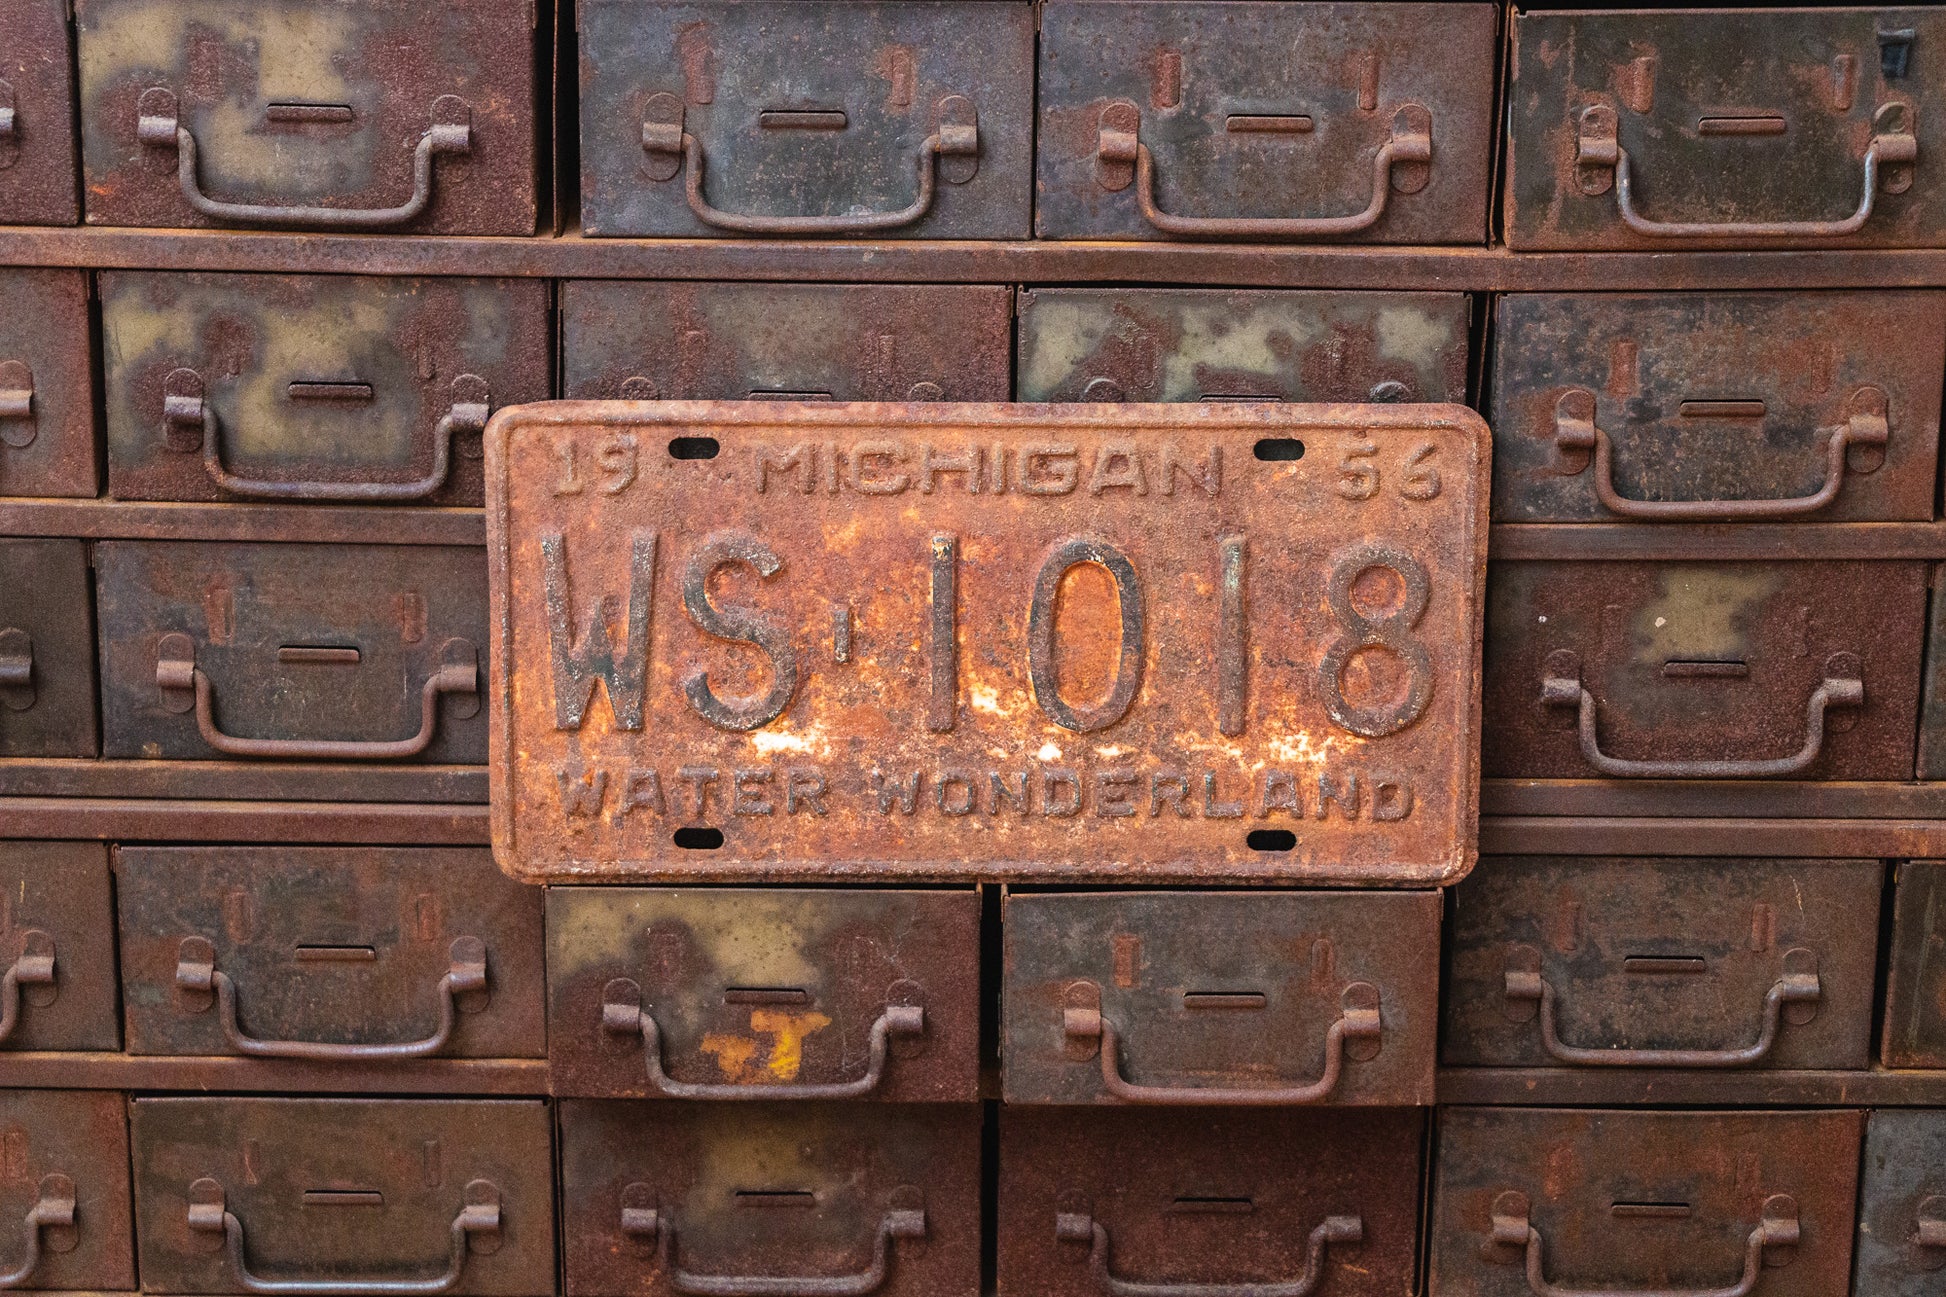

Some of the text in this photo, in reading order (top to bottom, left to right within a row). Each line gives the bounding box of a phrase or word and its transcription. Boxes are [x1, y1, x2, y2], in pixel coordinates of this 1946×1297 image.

[551, 430, 1442, 501] 19 MICHIGAN 56
[556, 766, 1415, 822] WATER WONDERLAND
